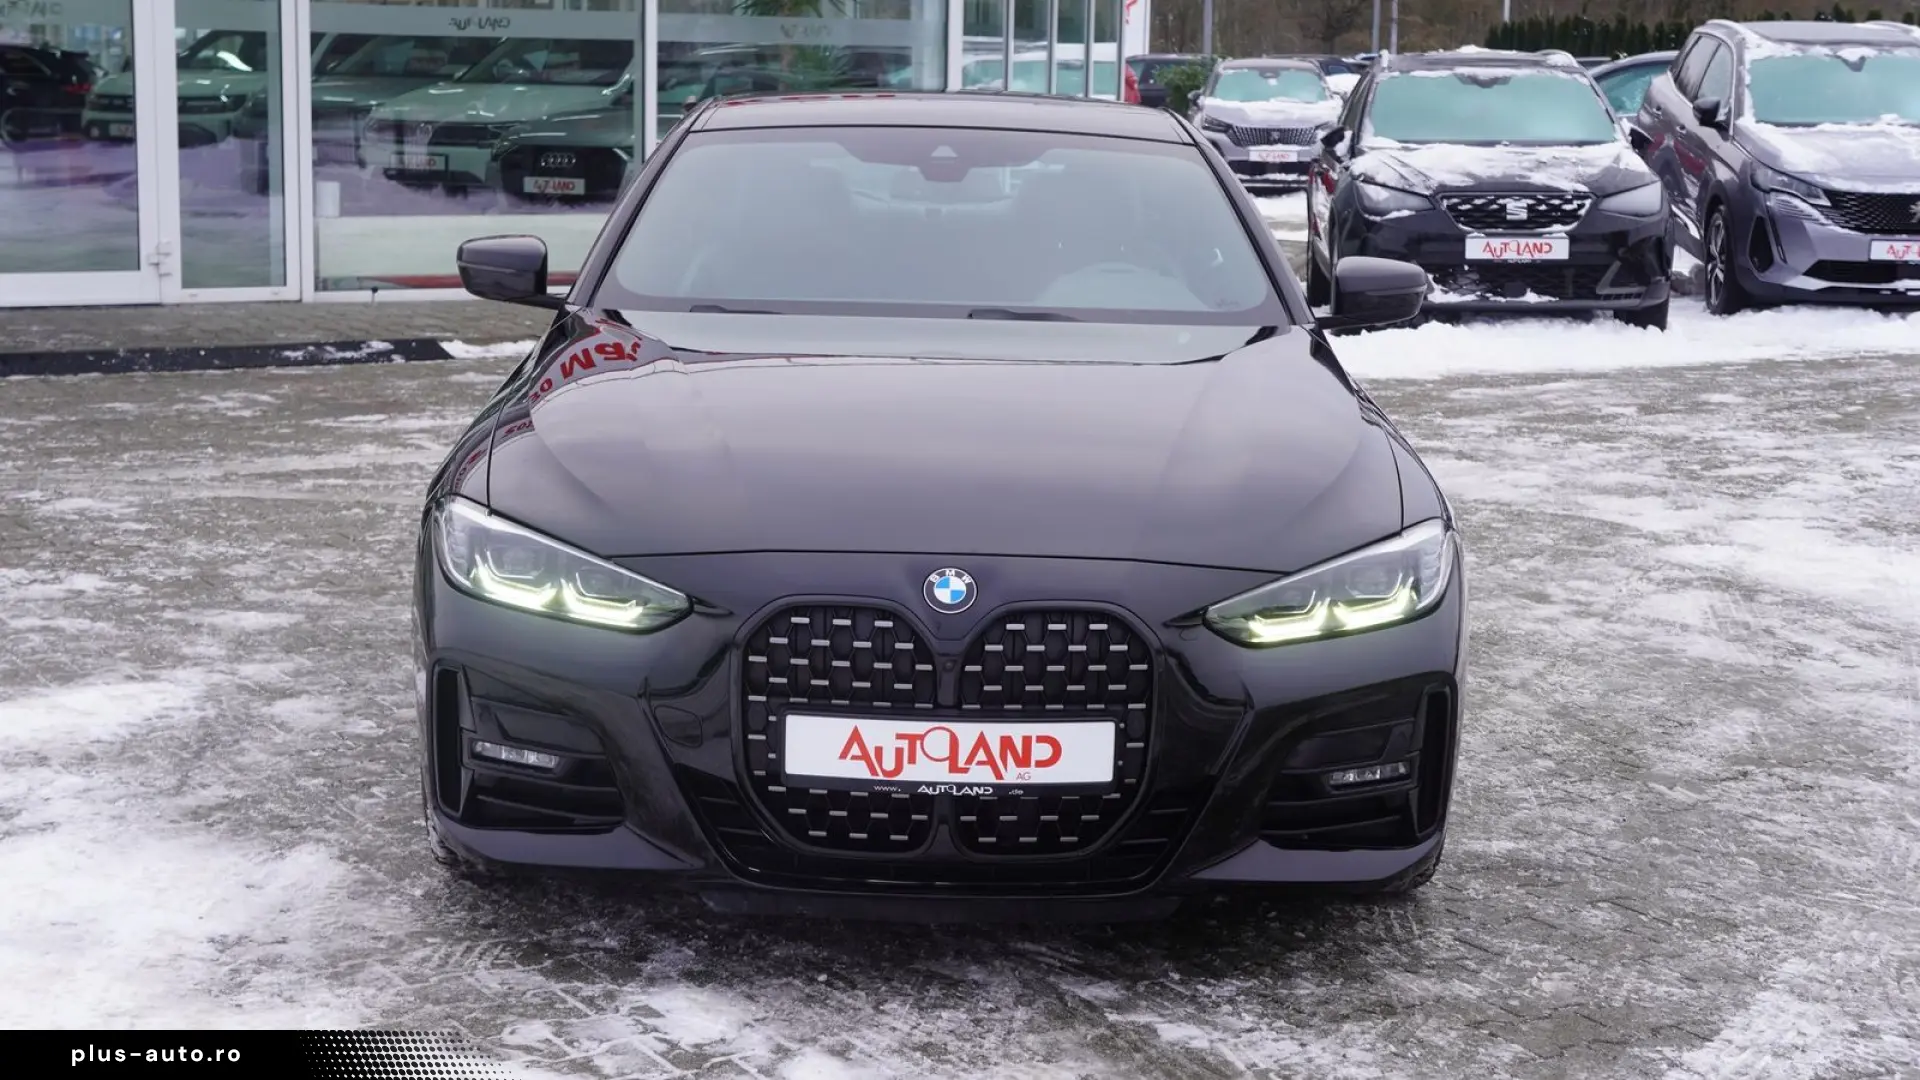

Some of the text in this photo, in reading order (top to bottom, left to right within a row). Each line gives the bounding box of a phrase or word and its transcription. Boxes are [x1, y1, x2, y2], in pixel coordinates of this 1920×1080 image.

[929, 568, 972, 584] BMW
[838, 725, 1062, 781] AUTOLAND
[1015, 772, 1032, 781] AG
[917, 784, 994, 796] AUTOLAND
